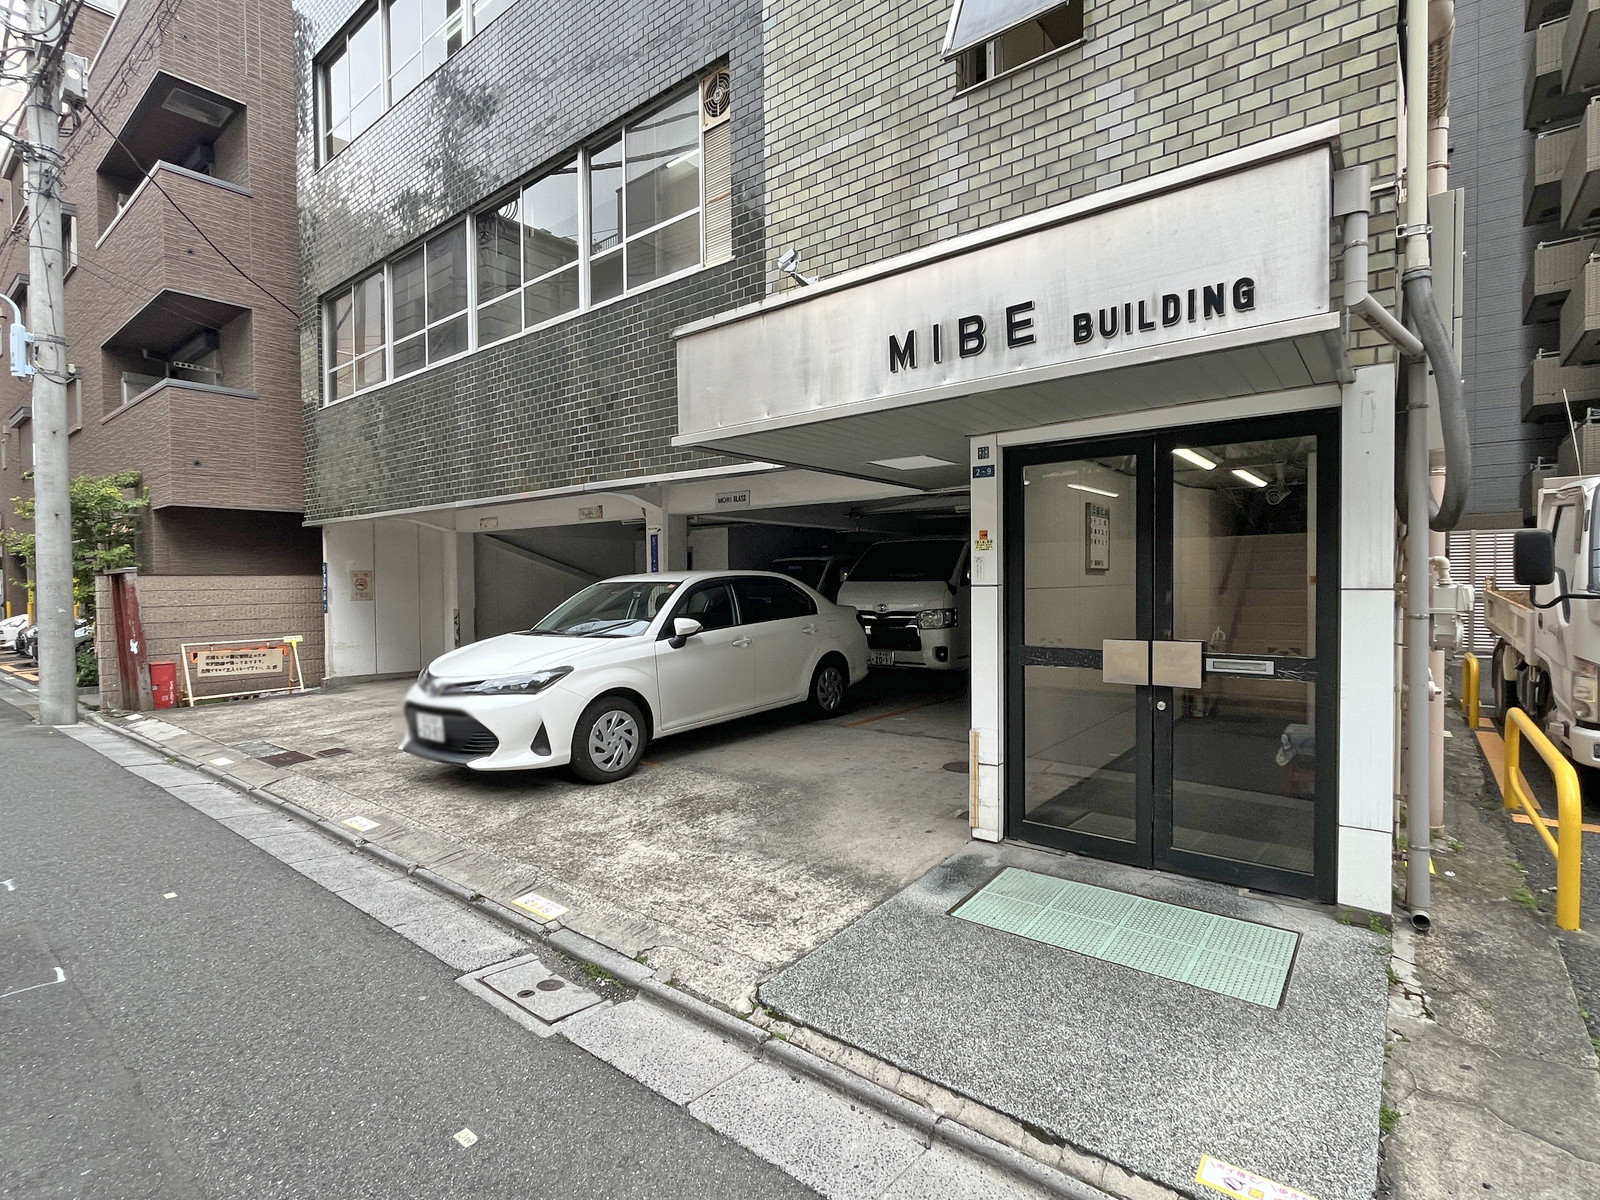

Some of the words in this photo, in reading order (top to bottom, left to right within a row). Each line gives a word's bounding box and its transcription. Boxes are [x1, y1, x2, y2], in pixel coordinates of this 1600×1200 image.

[889, 300, 1035, 373] MIBE
[1073, 277, 1256, 344] BUILDING
[975, 467, 992, 476] 2-9
